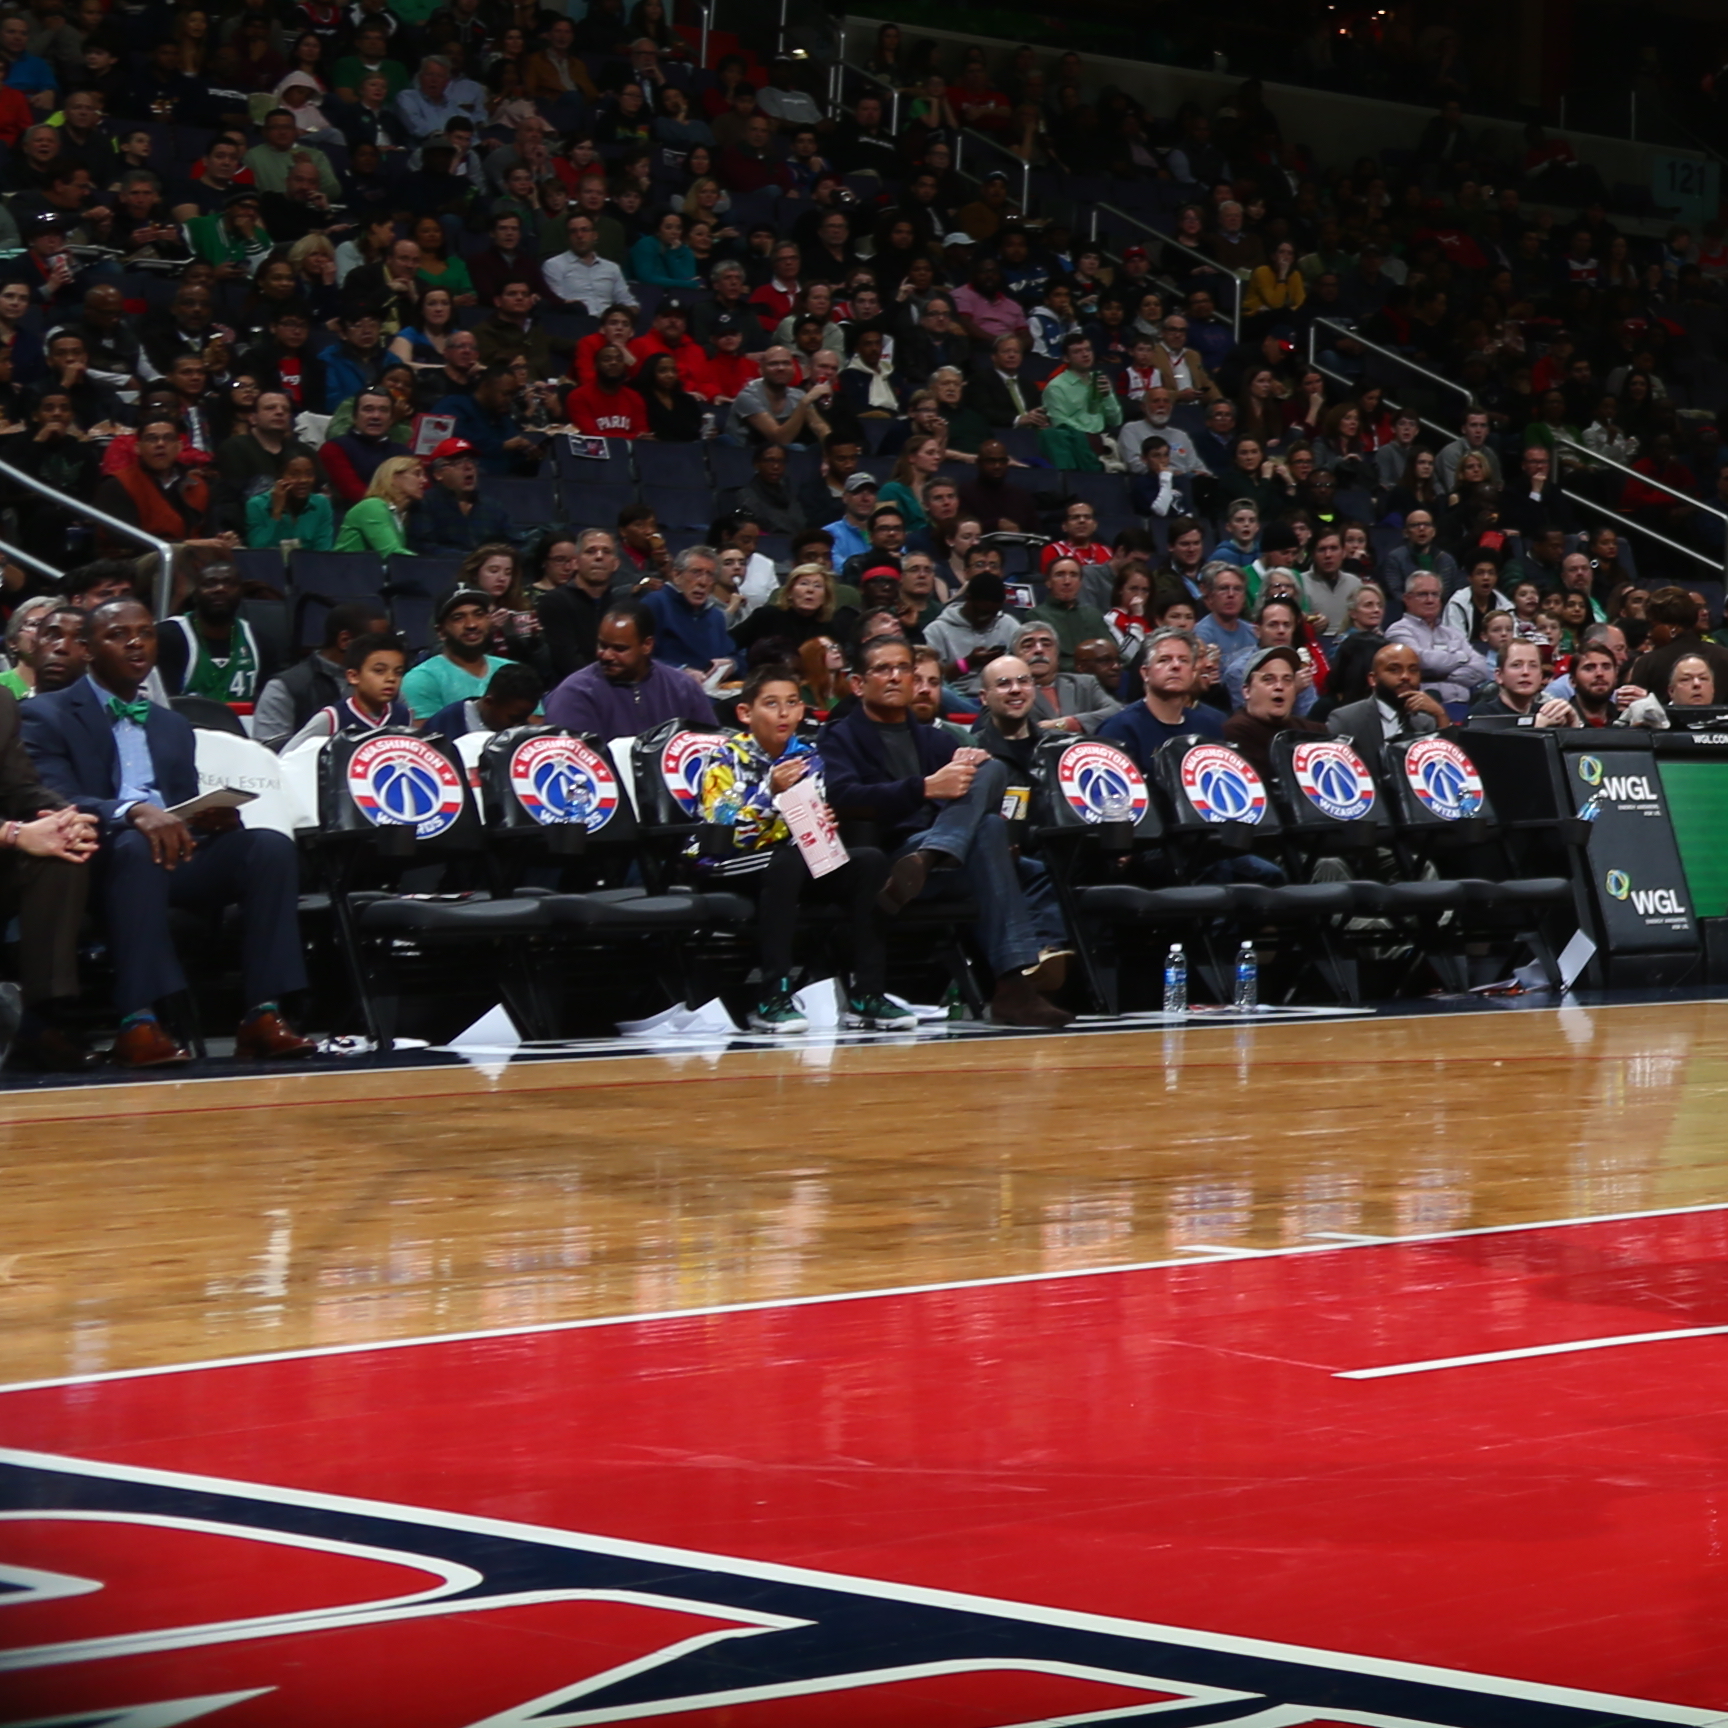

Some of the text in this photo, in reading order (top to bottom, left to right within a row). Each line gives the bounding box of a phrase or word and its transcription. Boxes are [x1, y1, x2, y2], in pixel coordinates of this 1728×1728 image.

[1667, 160, 1705, 195] 121
[229, 670, 259, 700] 41
[360, 735, 442, 771] WASHINGTON
[1603, 775, 1658, 801] WGL
[1631, 889, 1686, 915] WGL
